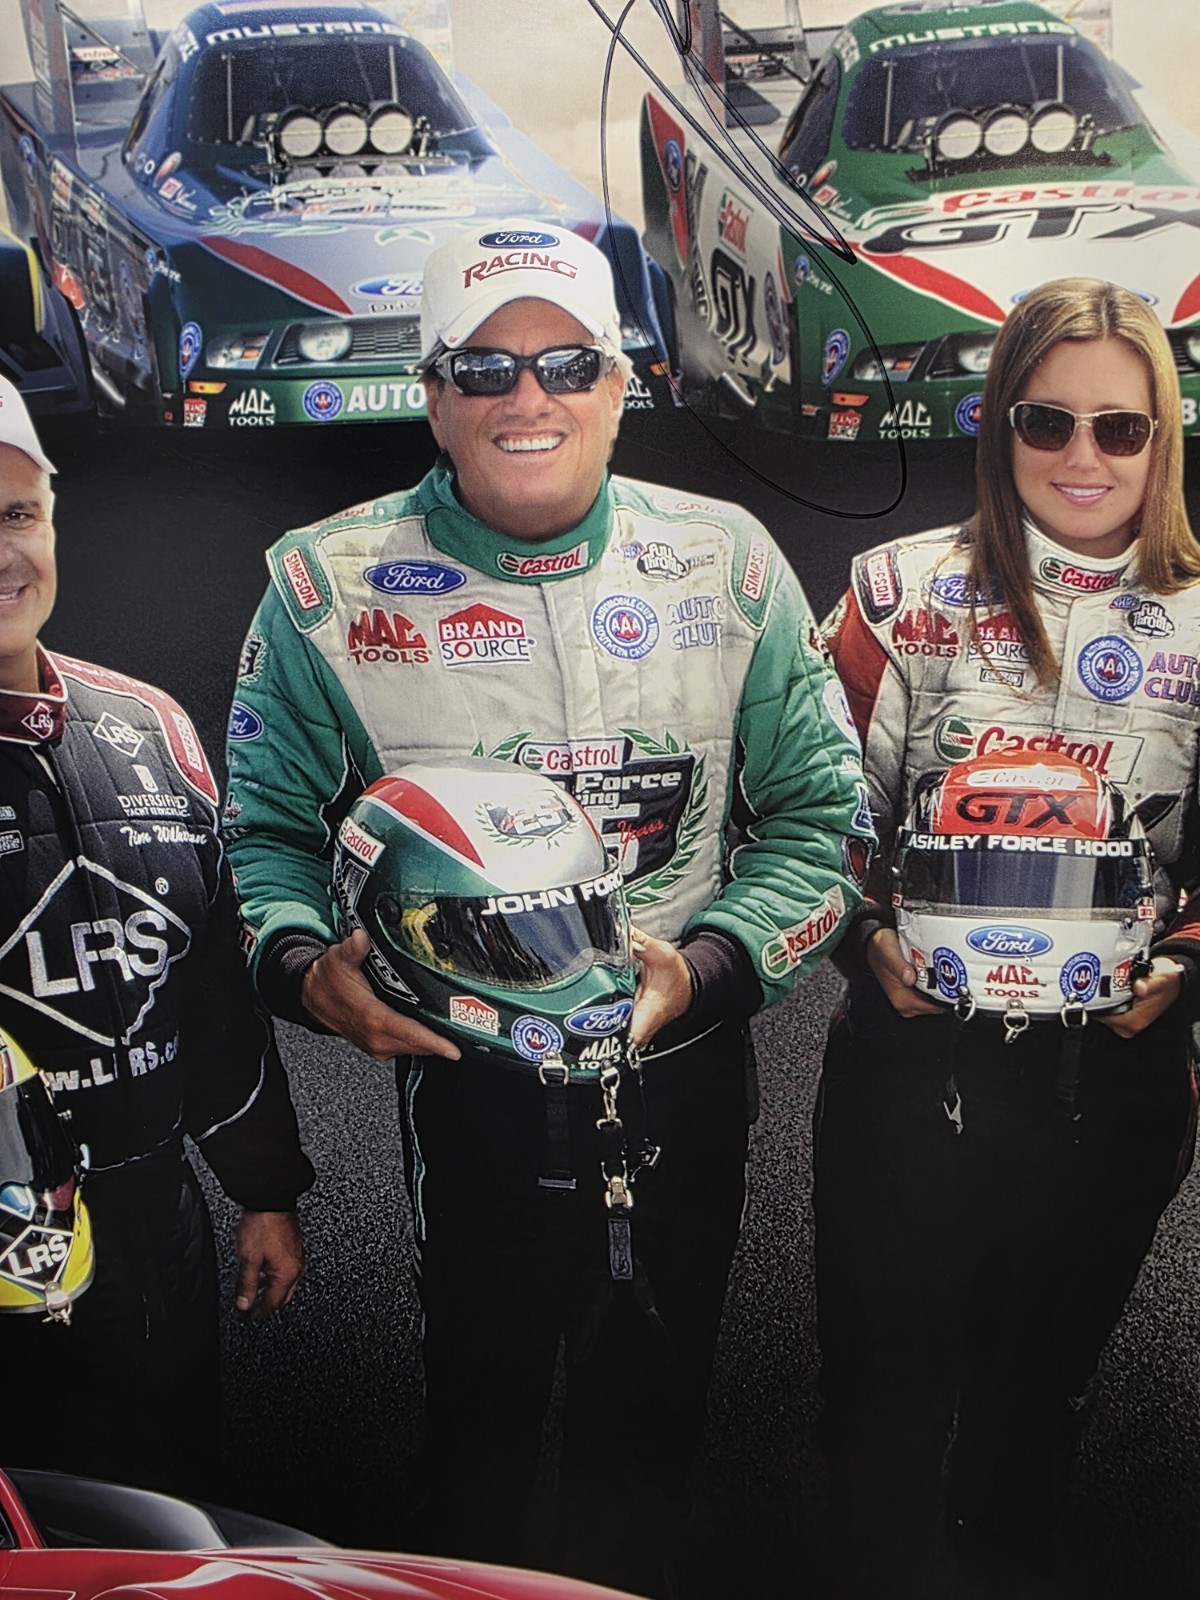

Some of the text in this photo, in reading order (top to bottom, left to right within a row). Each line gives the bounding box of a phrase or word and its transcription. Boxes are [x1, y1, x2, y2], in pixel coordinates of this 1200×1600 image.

[206, 22, 411, 45] MUSTANG
[869, 22, 1078, 52] MUSTANG
[495, 231, 543, 244] Ford
[860, 203, 1200, 254] GTX
[462, 252, 578, 288] RACING
[381, 279, 423, 295] Fo
[346, 383, 427, 412] AUTO
[625, 377, 651, 397] AC
[229, 388, 276, 414] MAC
[624, 400, 654, 409] OOLS
[229, 416, 275, 426] TOOLS
[880, 400, 931, 427] MAC
[879, 428, 931, 440] TOOLS
[519, 549, 581, 576] Castrol
[285, 553, 318, 605] SIMPSON
[383, 564, 444, 590] Ford
[1061, 567, 1117, 590] Castrol
[348, 609, 428, 650] MAC
[441, 620, 523, 639] BRAND
[611, 615, 641, 635] AAA
[349, 650, 430, 666] TOOLS
[441, 639, 529, 660] SOURCE
[894, 643, 958, 658] TOOLS
[968, 641, 1029, 659] SOURC
[1096, 657, 1124, 675] AAA
[1147, 651, 1200, 678] AUT
[30, 713, 54, 729] LRS
[98, 722, 138, 744] LRS
[546, 745, 618, 771] Castrol
[575, 772, 682, 793] Force
[993, 772, 1064, 786] Casol
[117, 794, 188, 809] DIVERSIFID
[576, 790, 620, 810] ing
[956, 793, 1081, 829] GTX
[342, 826, 377, 861] Castrol
[908, 833, 1132, 857] ASHLEY FORCE HOOD
[481, 889, 575, 915] JOHN
[787, 906, 838, 963] strol
[982, 930, 1034, 953] Ford
[26, 909, 168, 997] LRS
[986, 965, 1039, 985] MAC
[985, 987, 1039, 998] TOOLS
[453, 1001, 494, 1020] BRAND
[583, 1008, 625, 1030] Ford
[526, 1030, 547, 1045] AAA
[579, 1036, 621, 1060] MAC
[577, 1053, 620, 1070] TOS
[8, 1234, 67, 1277] LRS
